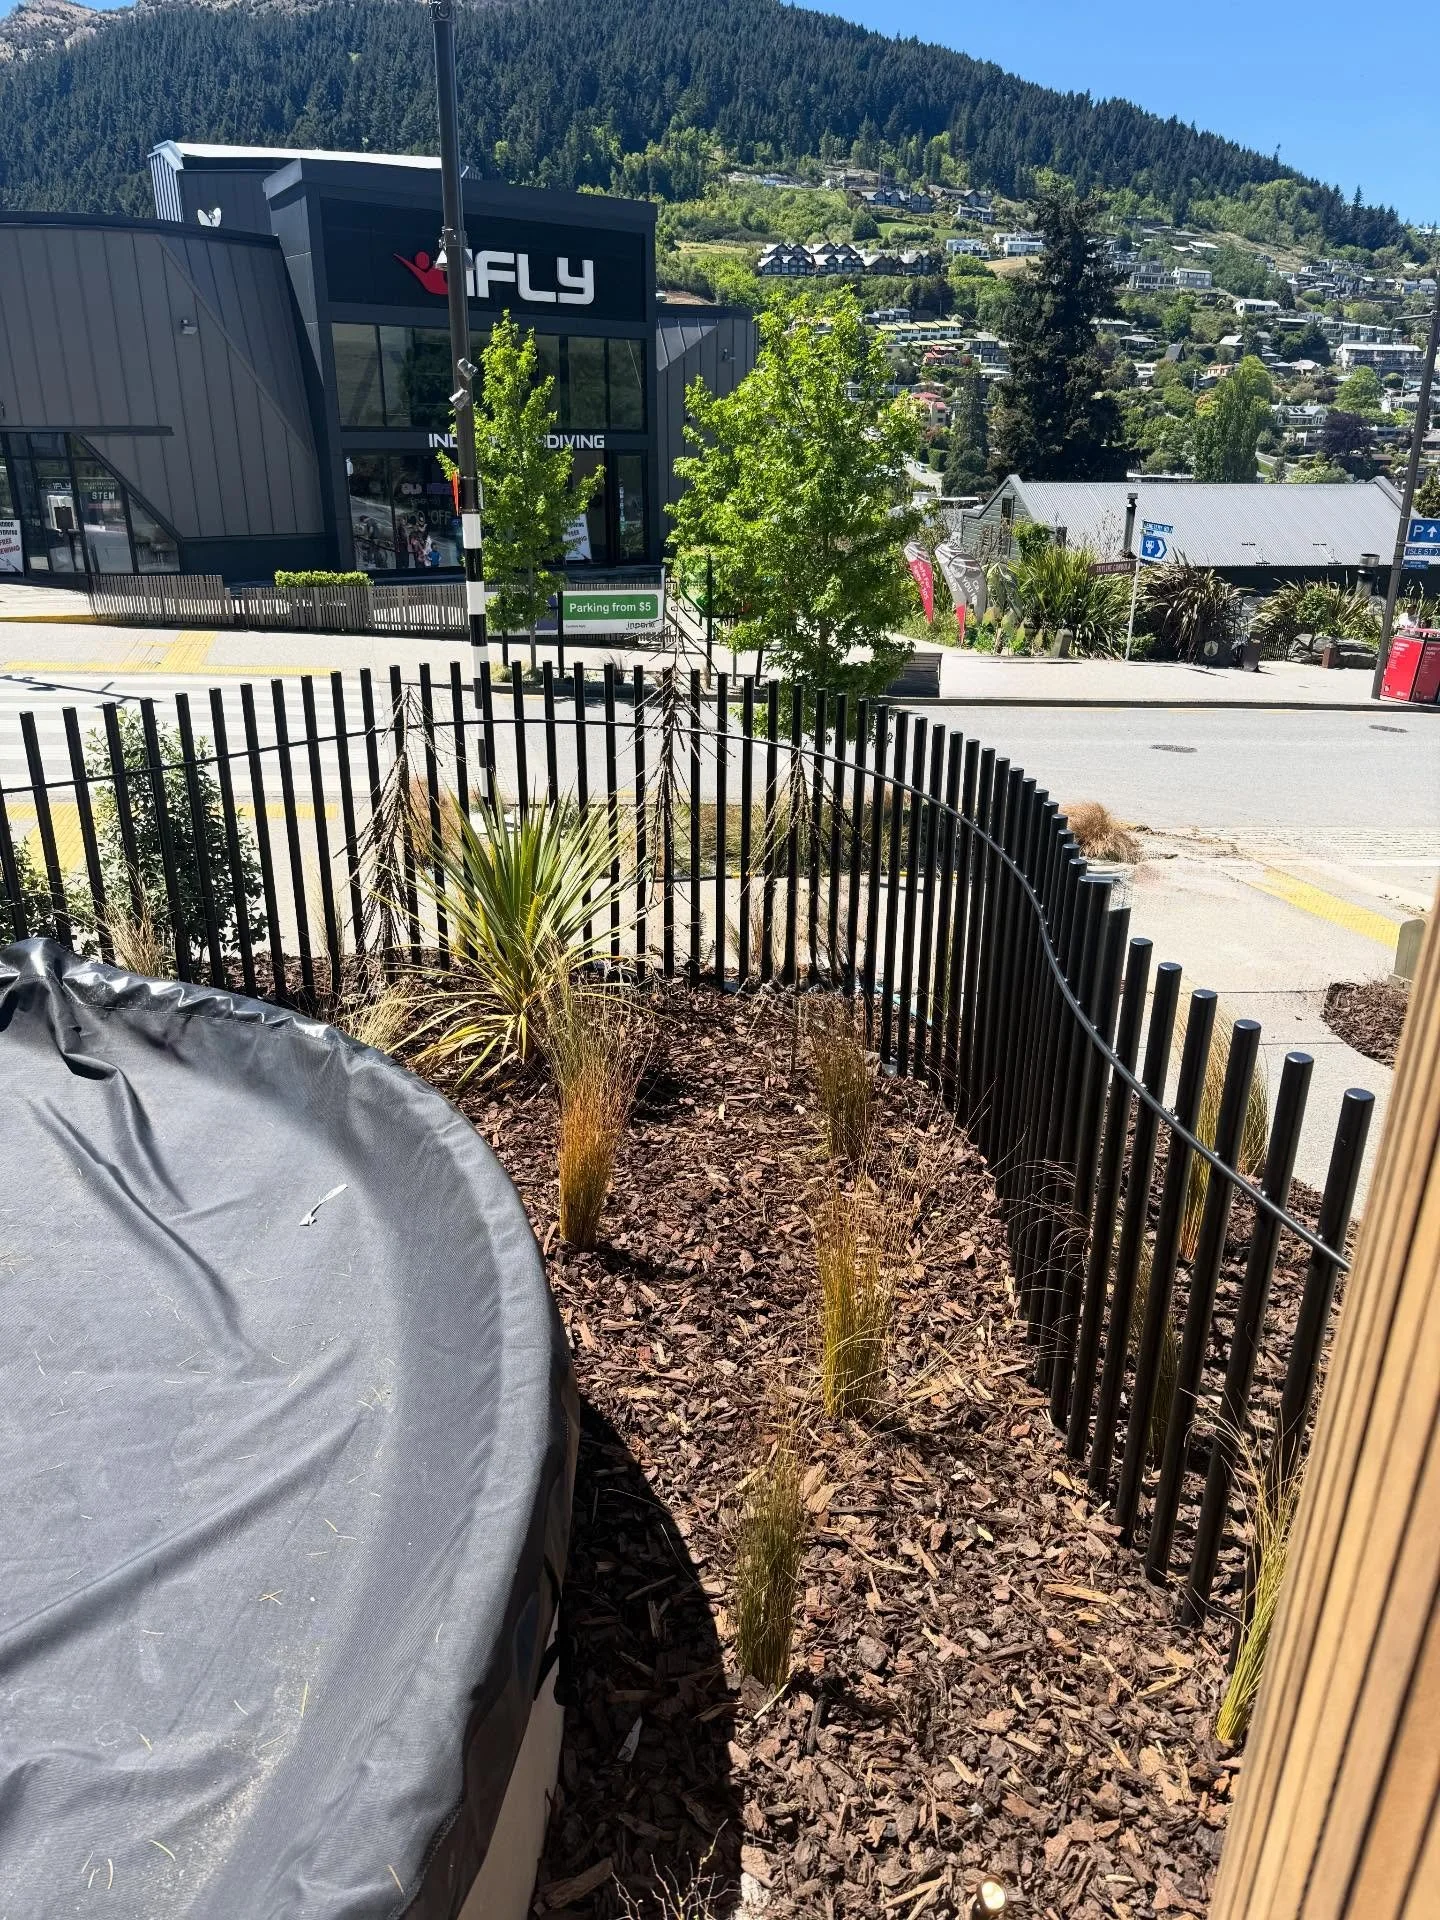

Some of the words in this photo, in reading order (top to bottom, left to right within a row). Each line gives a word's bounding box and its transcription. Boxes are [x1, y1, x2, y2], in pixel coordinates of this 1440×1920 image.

[92, 491, 115, 500] STEM
[1413, 525, 1424, 537] P
[569, 602, 609, 614] Parking
[612, 602, 636, 612] from
[639, 601, 651, 612] $5
